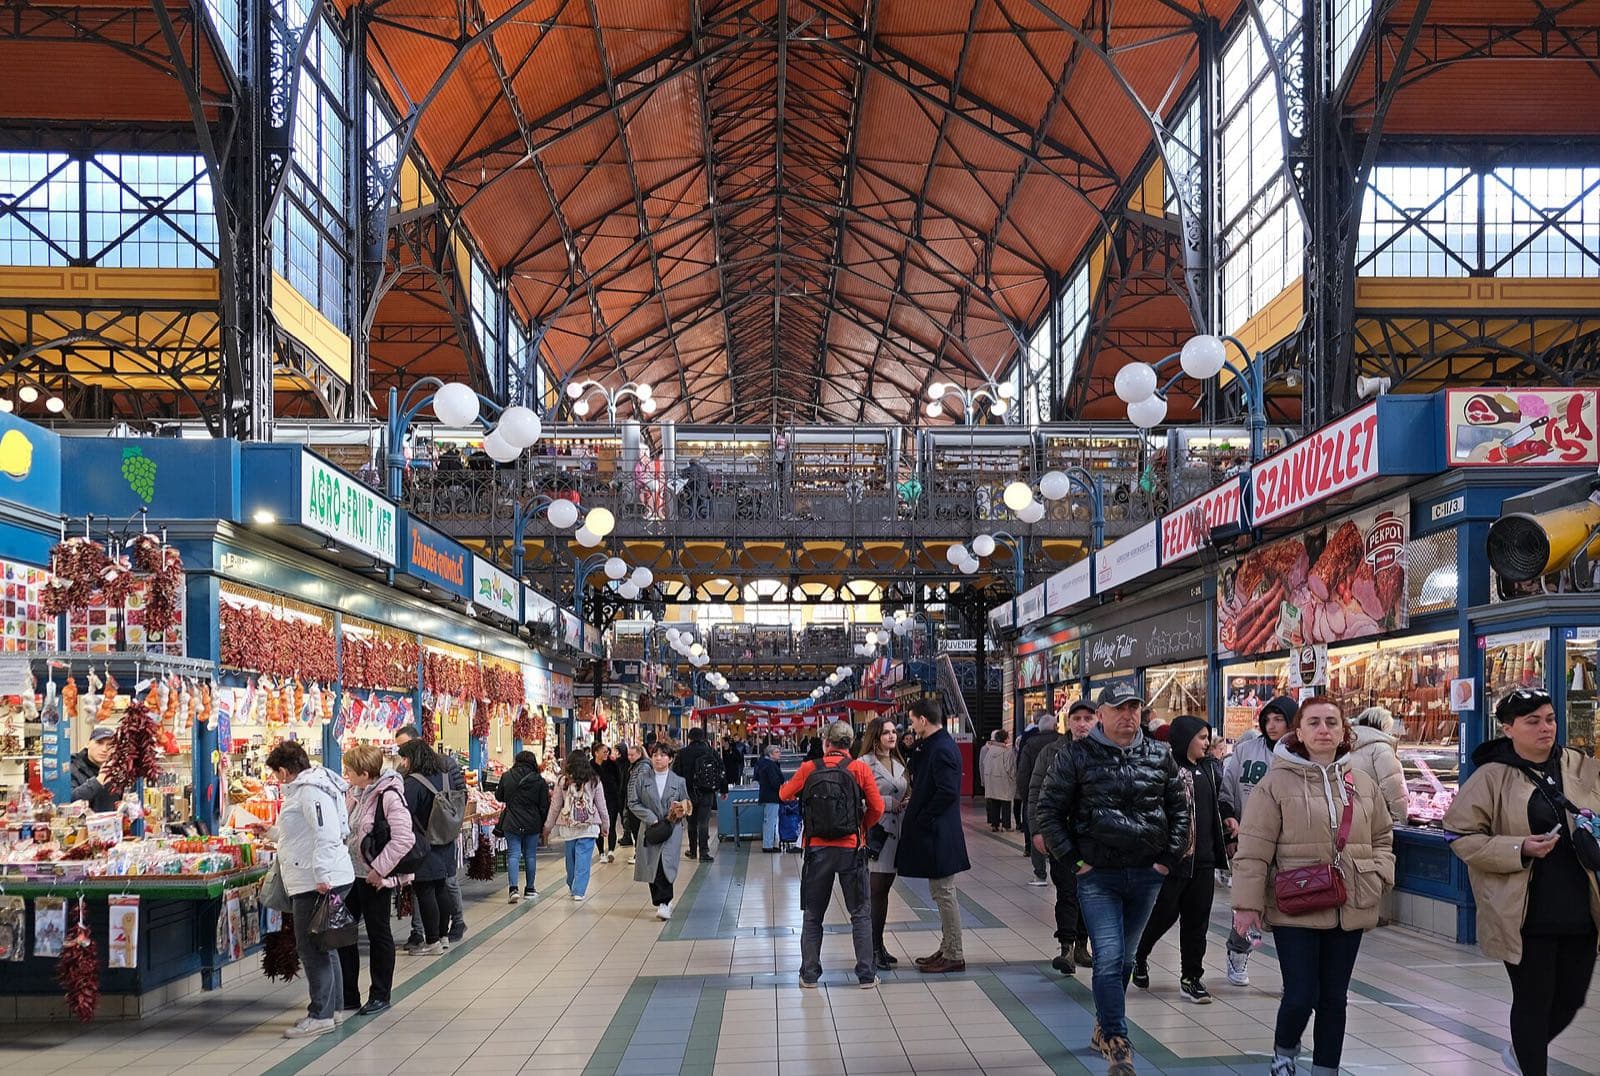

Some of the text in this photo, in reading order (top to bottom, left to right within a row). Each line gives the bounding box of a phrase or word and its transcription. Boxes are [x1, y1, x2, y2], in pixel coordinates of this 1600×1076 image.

[1255, 414, 1377, 518] SZAKÜZLET
[309, 465, 373, 546] AGRO-FRUIT
[1369, 526, 1402, 549] PEKPOL
[1239, 760, 1267, 785] 18
